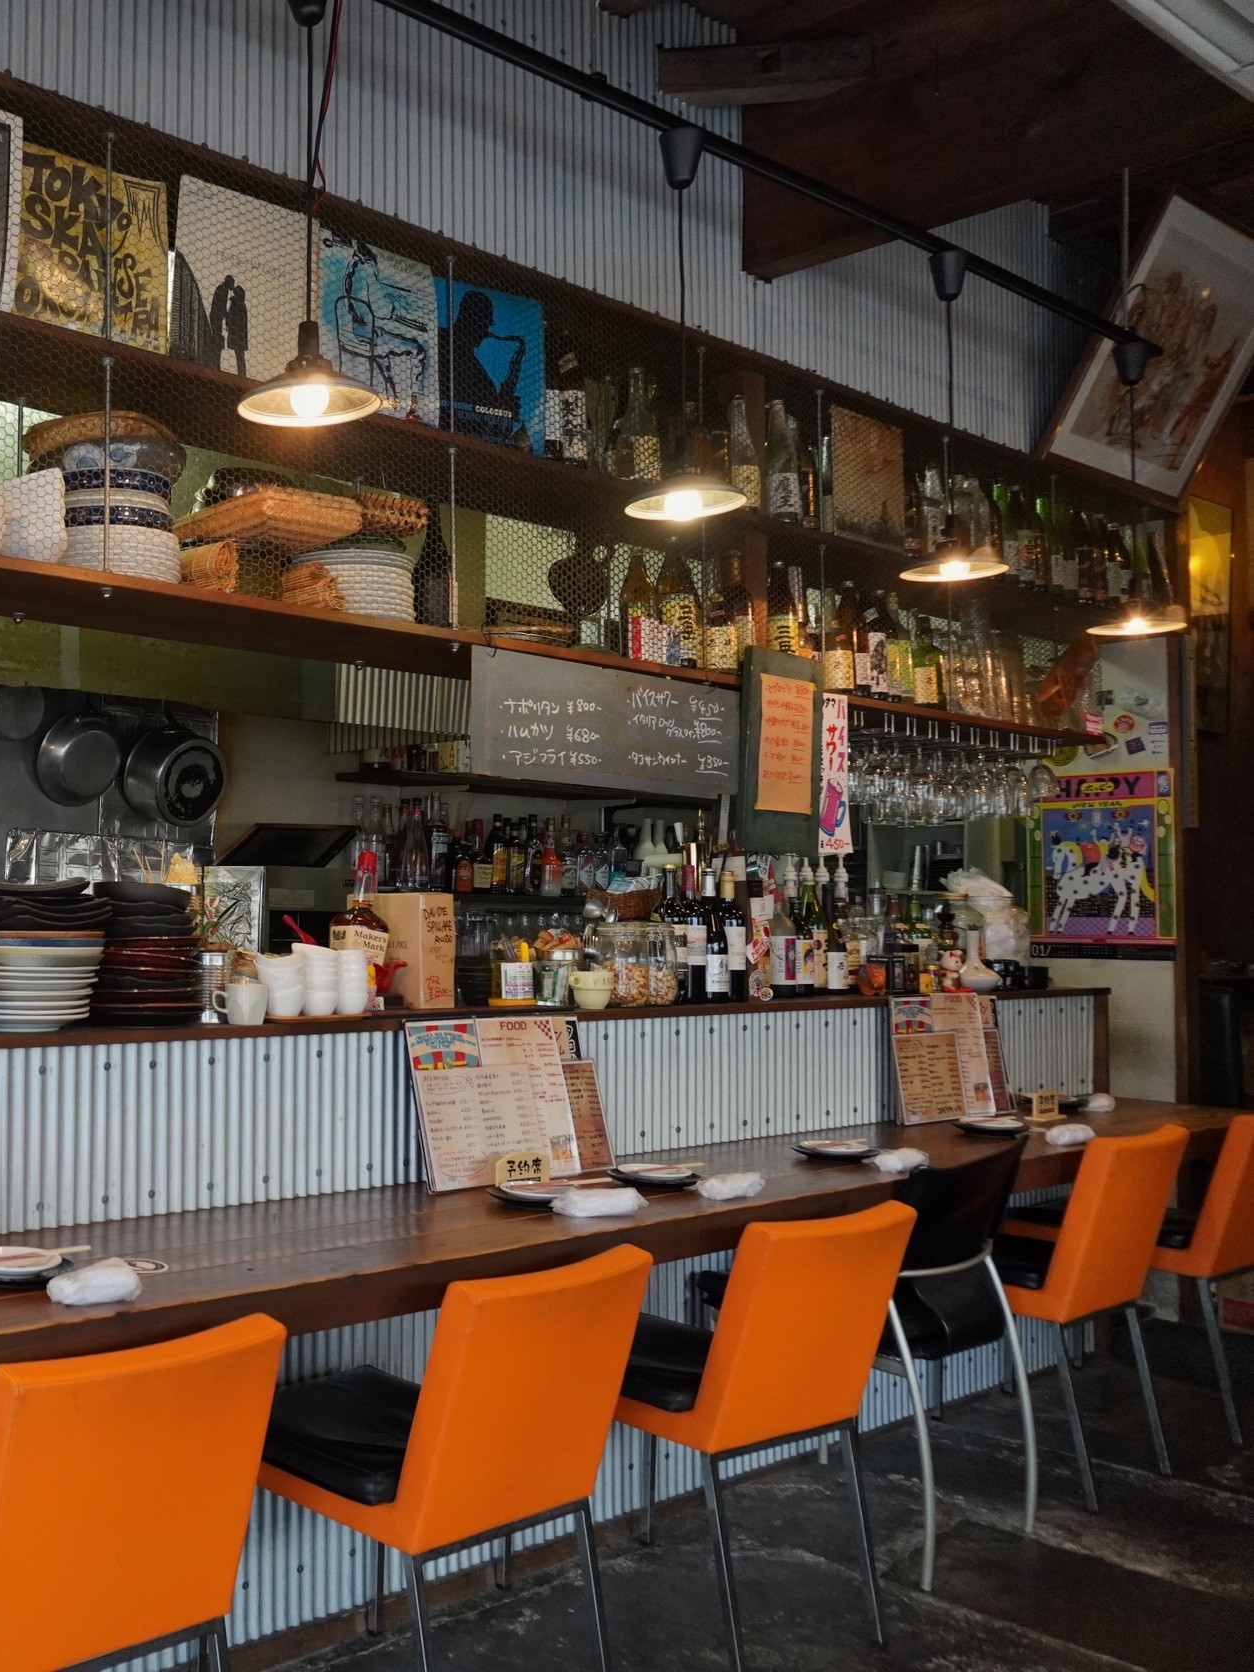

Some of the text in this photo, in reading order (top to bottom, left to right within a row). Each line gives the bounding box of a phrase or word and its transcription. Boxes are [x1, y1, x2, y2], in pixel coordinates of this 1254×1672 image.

[22, 151, 133, 232] TOKYO
[20, 193, 106, 261] SKA
[475, 405, 512, 419] COLOSSUS
[503, 699, 560, 715] ナポリタン
[507, 723, 554, 741] ハムカツ
[836, 698, 846, 773] バイス
[826, 724, 838, 771] サワー
[508, 749, 566, 765] アジフライ
[423, 906, 449, 920] DAVIDE
[353, 929, 387, 944] Maker's
[362, 939, 385, 952] Mark
[500, 1021, 527, 1031] FOOD
[506, 1156, 543, 1178] 予約席
